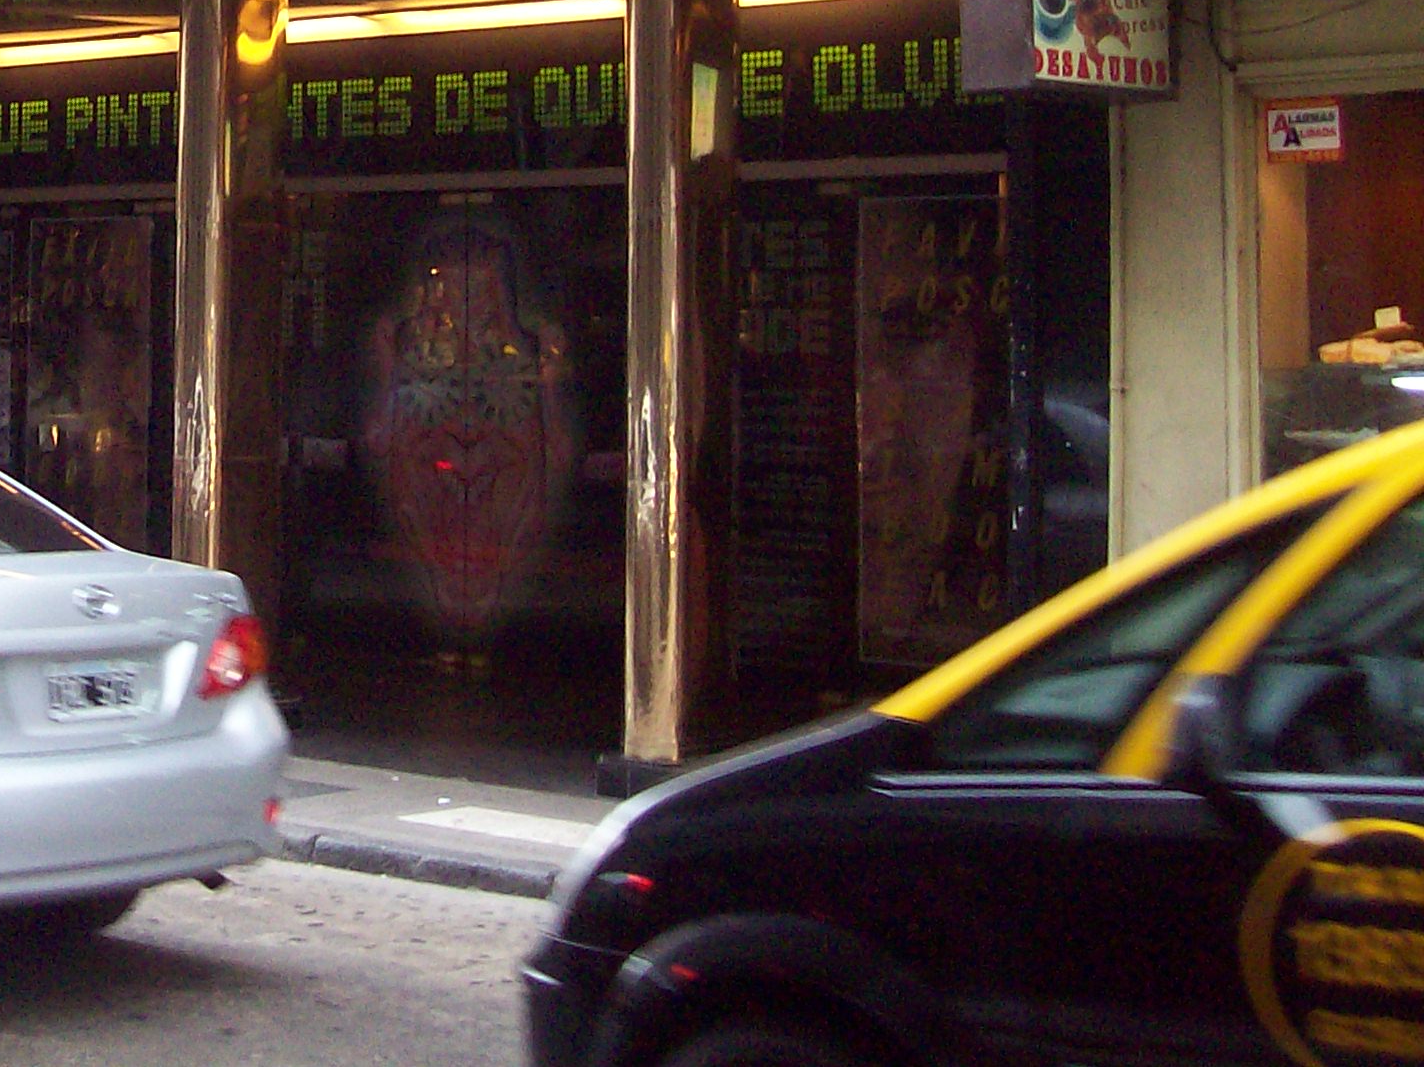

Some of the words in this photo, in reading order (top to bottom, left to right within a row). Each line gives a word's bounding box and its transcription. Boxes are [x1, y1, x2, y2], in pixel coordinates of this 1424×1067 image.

[66, 90, 178, 150] PINT
[435, 69, 509, 136] DE
[532, 62, 626, 128] QU
[742, 49, 783, 117] E
[812, 35, 963, 113] OLV
